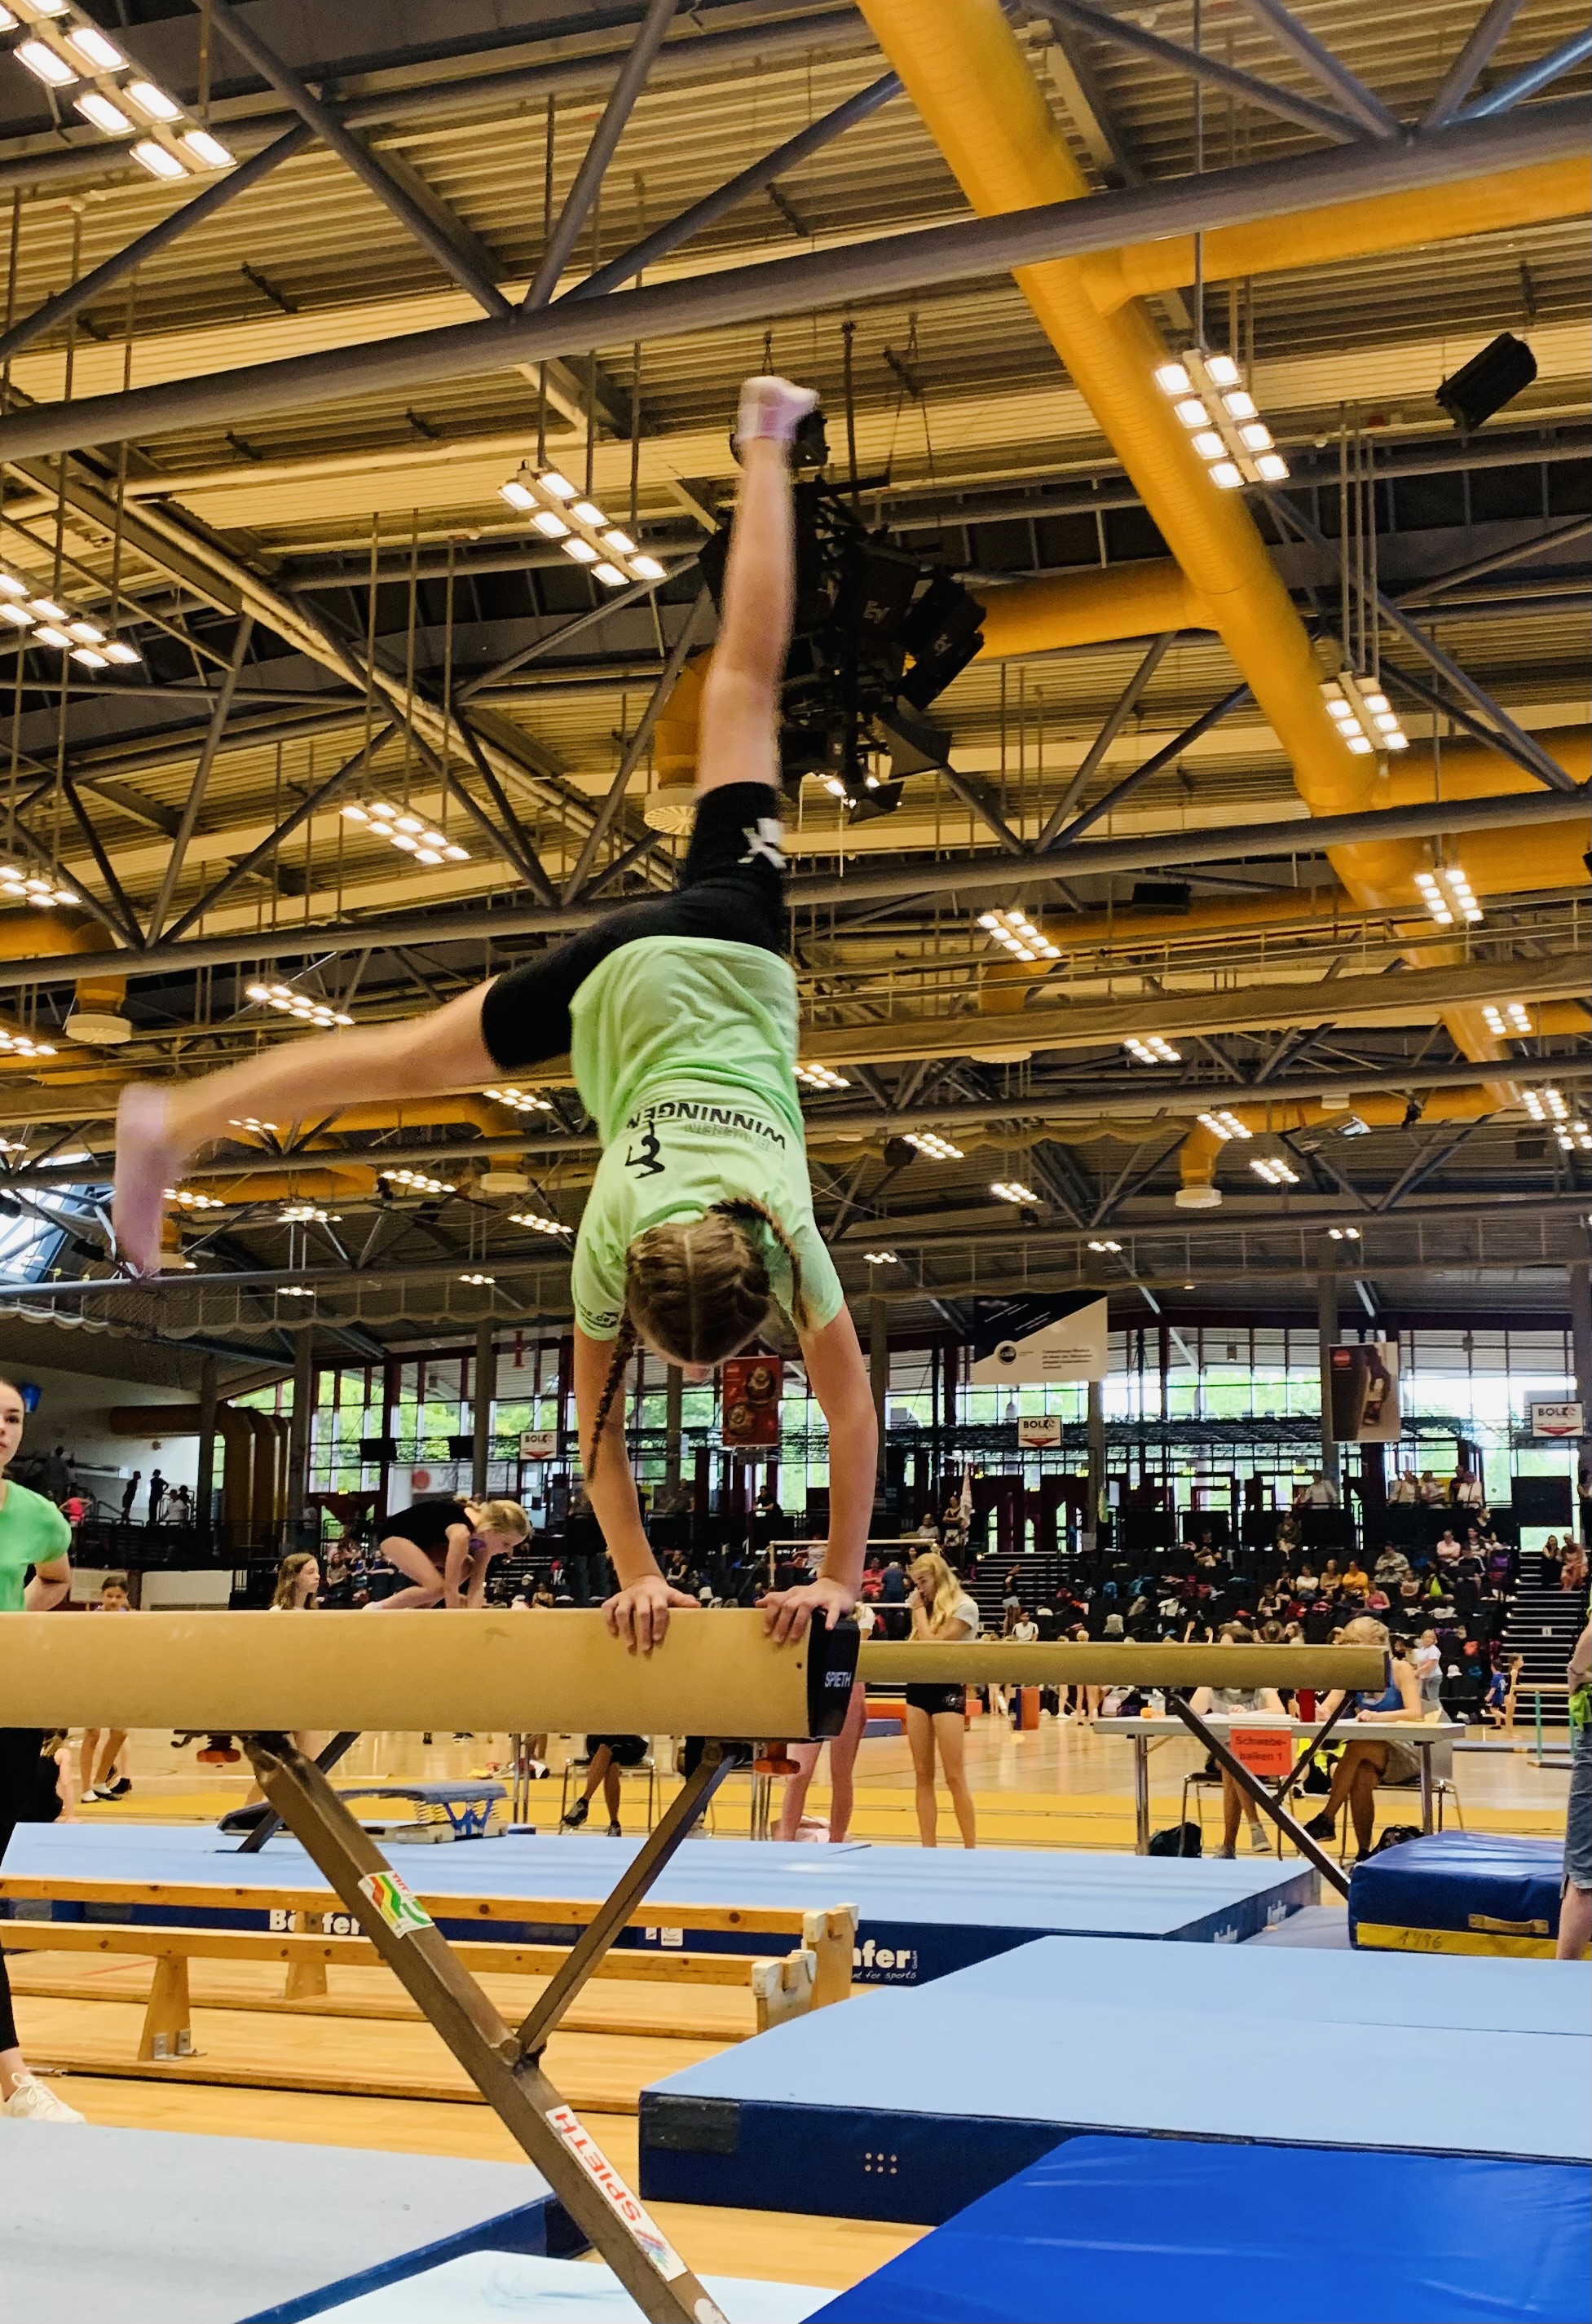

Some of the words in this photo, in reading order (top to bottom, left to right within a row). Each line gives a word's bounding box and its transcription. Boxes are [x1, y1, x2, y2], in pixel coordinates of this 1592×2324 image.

[626, 1102, 786, 1150] WINNINGEN
[1236, 1735, 1287, 1747] Schwebe-
[1277, 1752, 1282, 1761] 1
[270, 1910, 360, 1934] Bfer
[884, 1970, 917, 1981] sports
[554, 2113, 642, 2221] SPIETH
